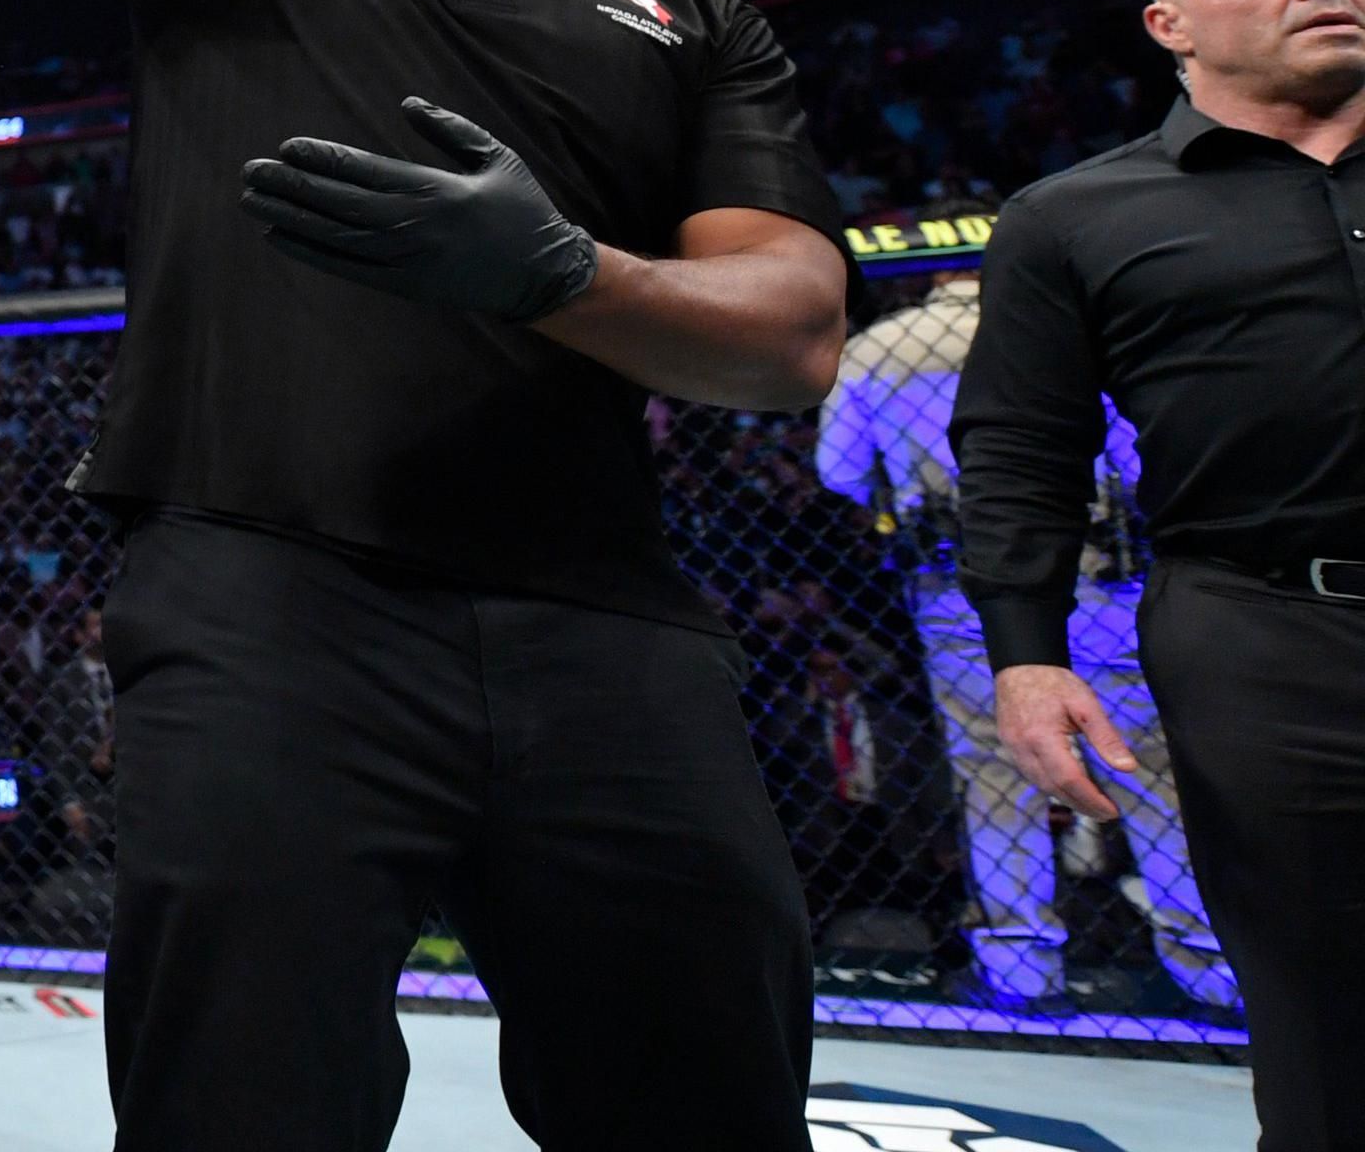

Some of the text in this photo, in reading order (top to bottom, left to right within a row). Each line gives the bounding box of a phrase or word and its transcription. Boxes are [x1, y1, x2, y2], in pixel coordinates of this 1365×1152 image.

[596, 3, 683, 45] NEVADA ATHLETIC
[919, 215, 999, 248] NU
